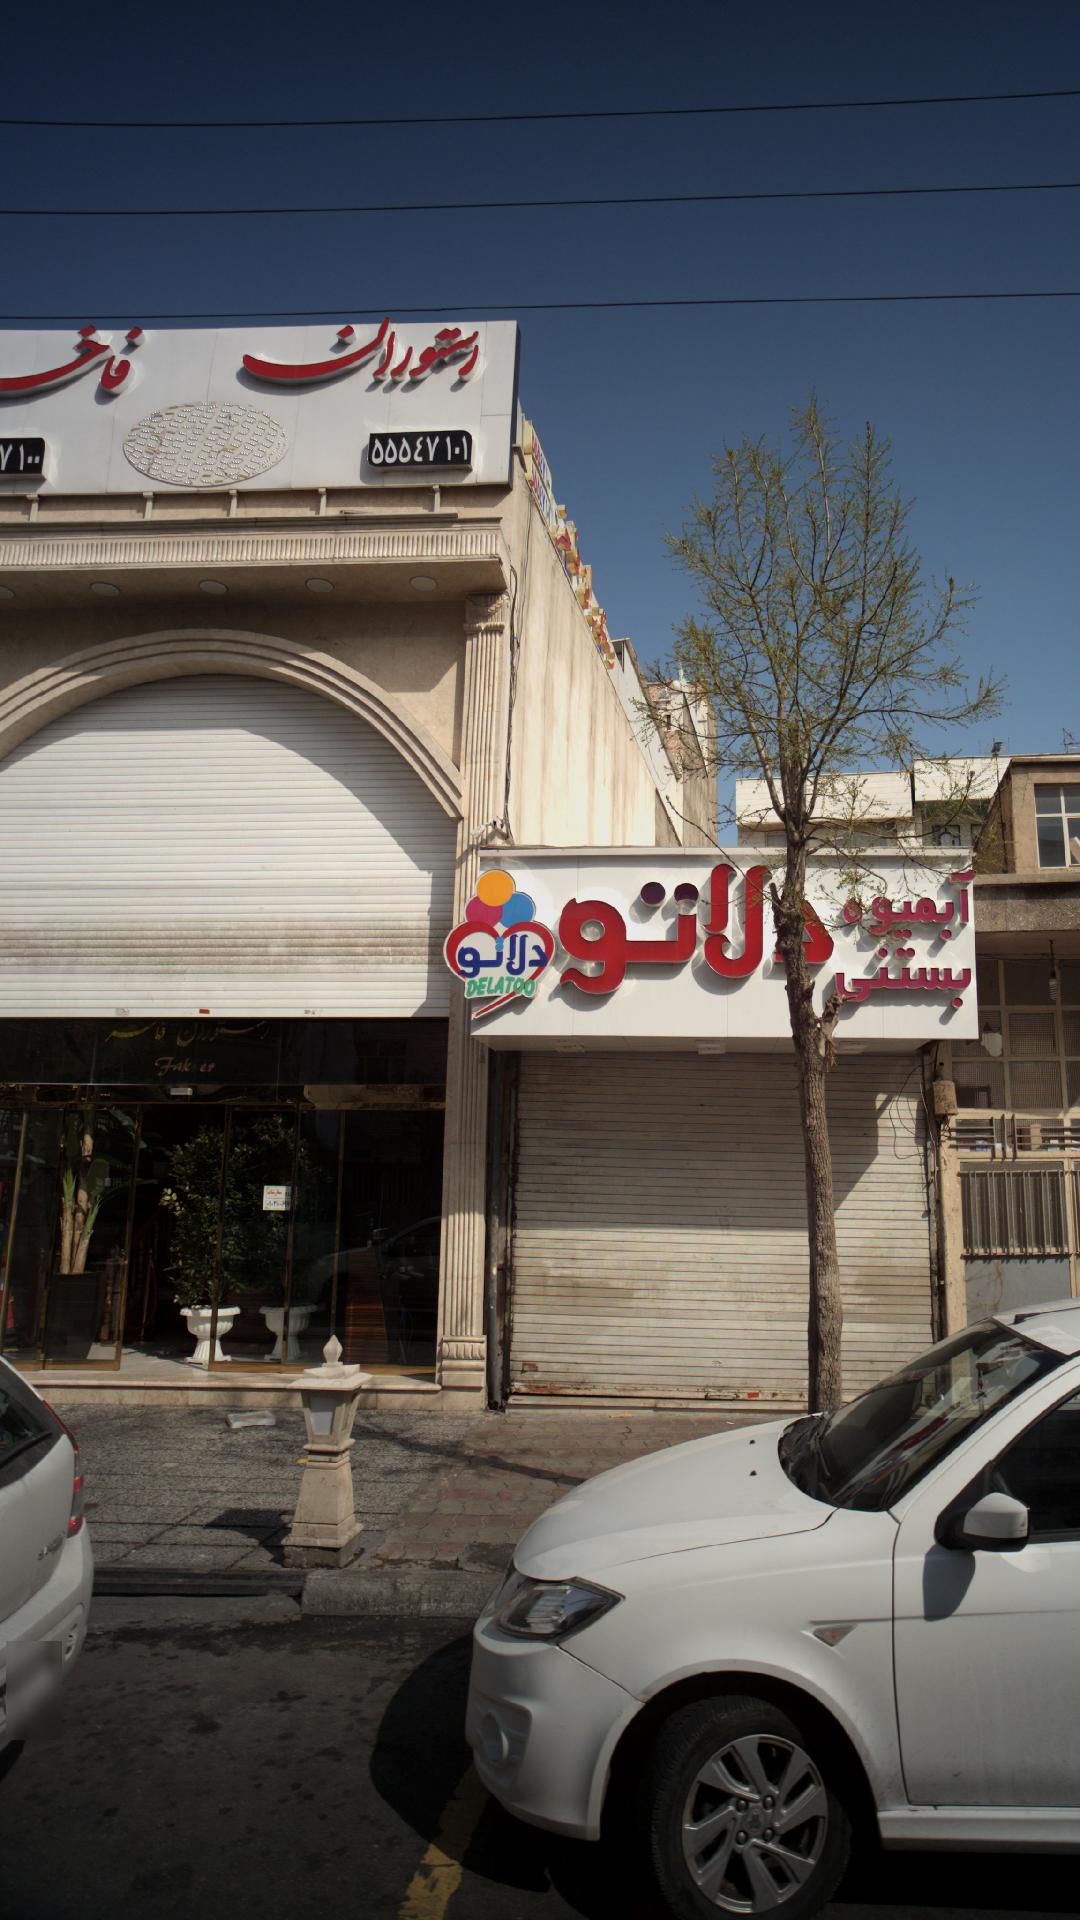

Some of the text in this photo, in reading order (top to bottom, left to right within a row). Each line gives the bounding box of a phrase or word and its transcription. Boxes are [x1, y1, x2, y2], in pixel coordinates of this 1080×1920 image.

[243, 317, 479, 382] رستوران
[559, 863, 835, 995] دلاتو
[843, 870, 976, 939] آبمیوه
[458, 934, 549, 978] دلاتو
[466, 976, 536, 997] DELATOO
[835, 948, 971, 1008] بستنی
